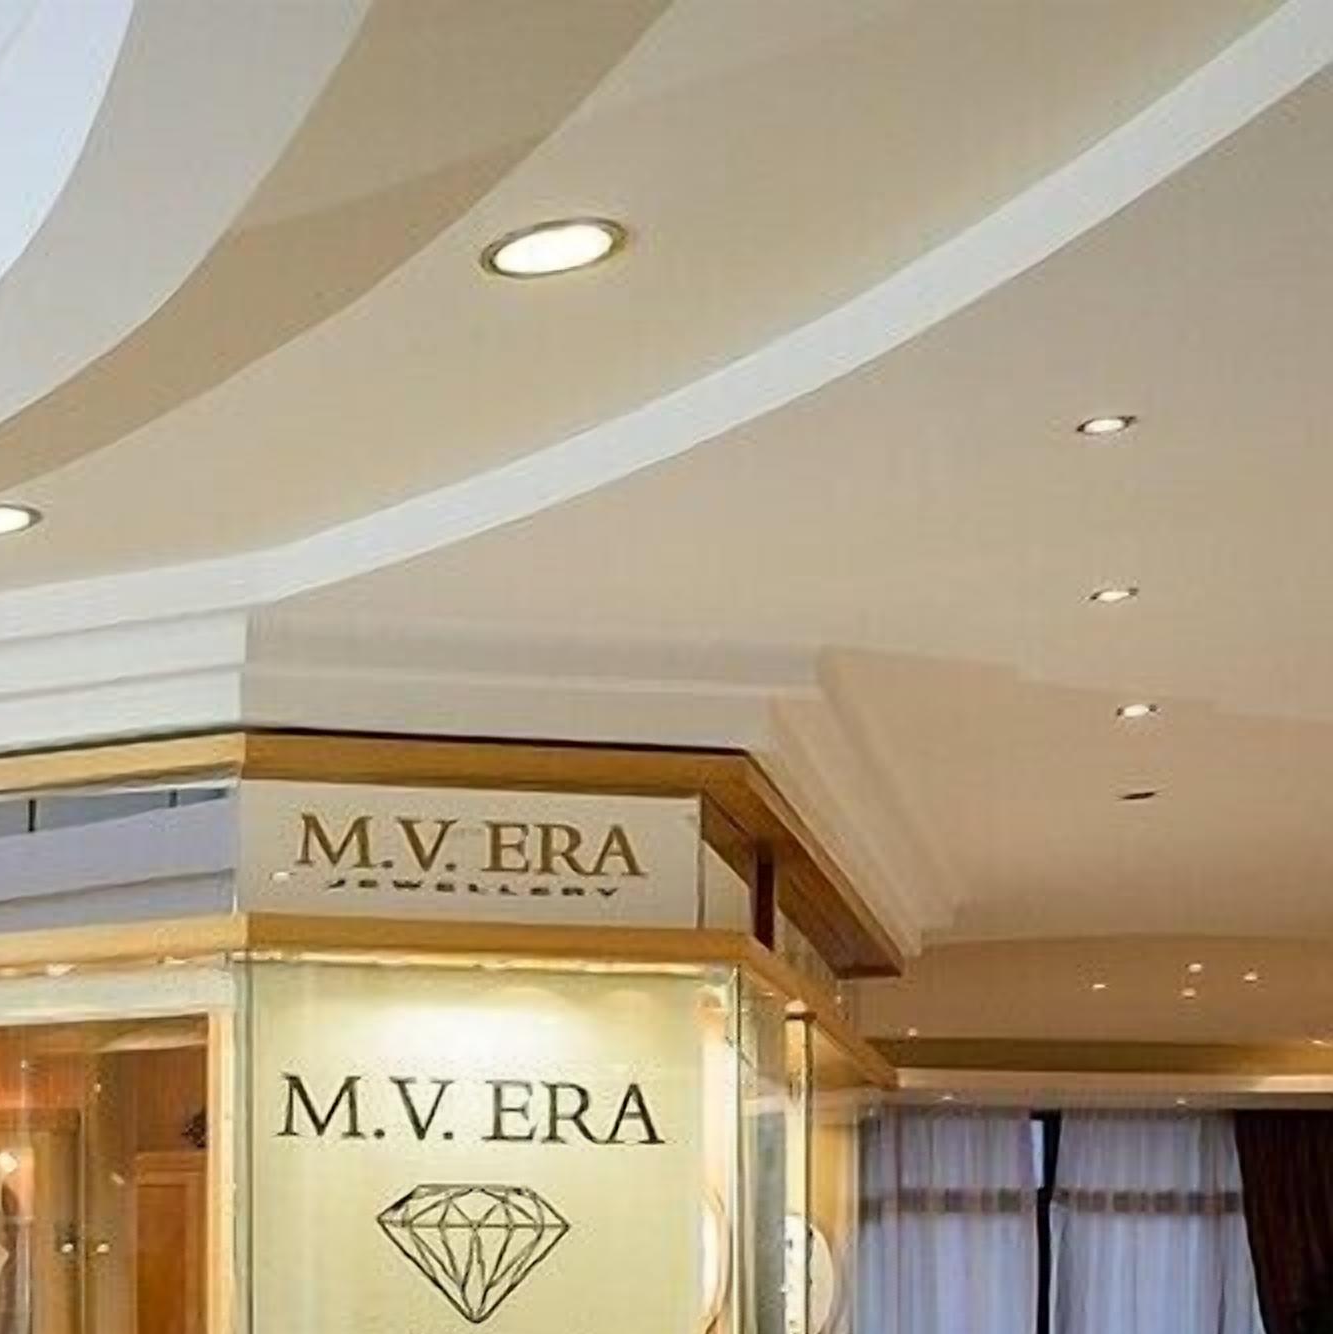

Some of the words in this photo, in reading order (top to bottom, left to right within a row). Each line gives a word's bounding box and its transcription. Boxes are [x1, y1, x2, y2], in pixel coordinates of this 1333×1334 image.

[295, 812, 458, 872] M.V.
[480, 820, 647, 878] ERA
[272, 1072, 455, 1142] M.V.
[479, 1080, 666, 1146] ERA
